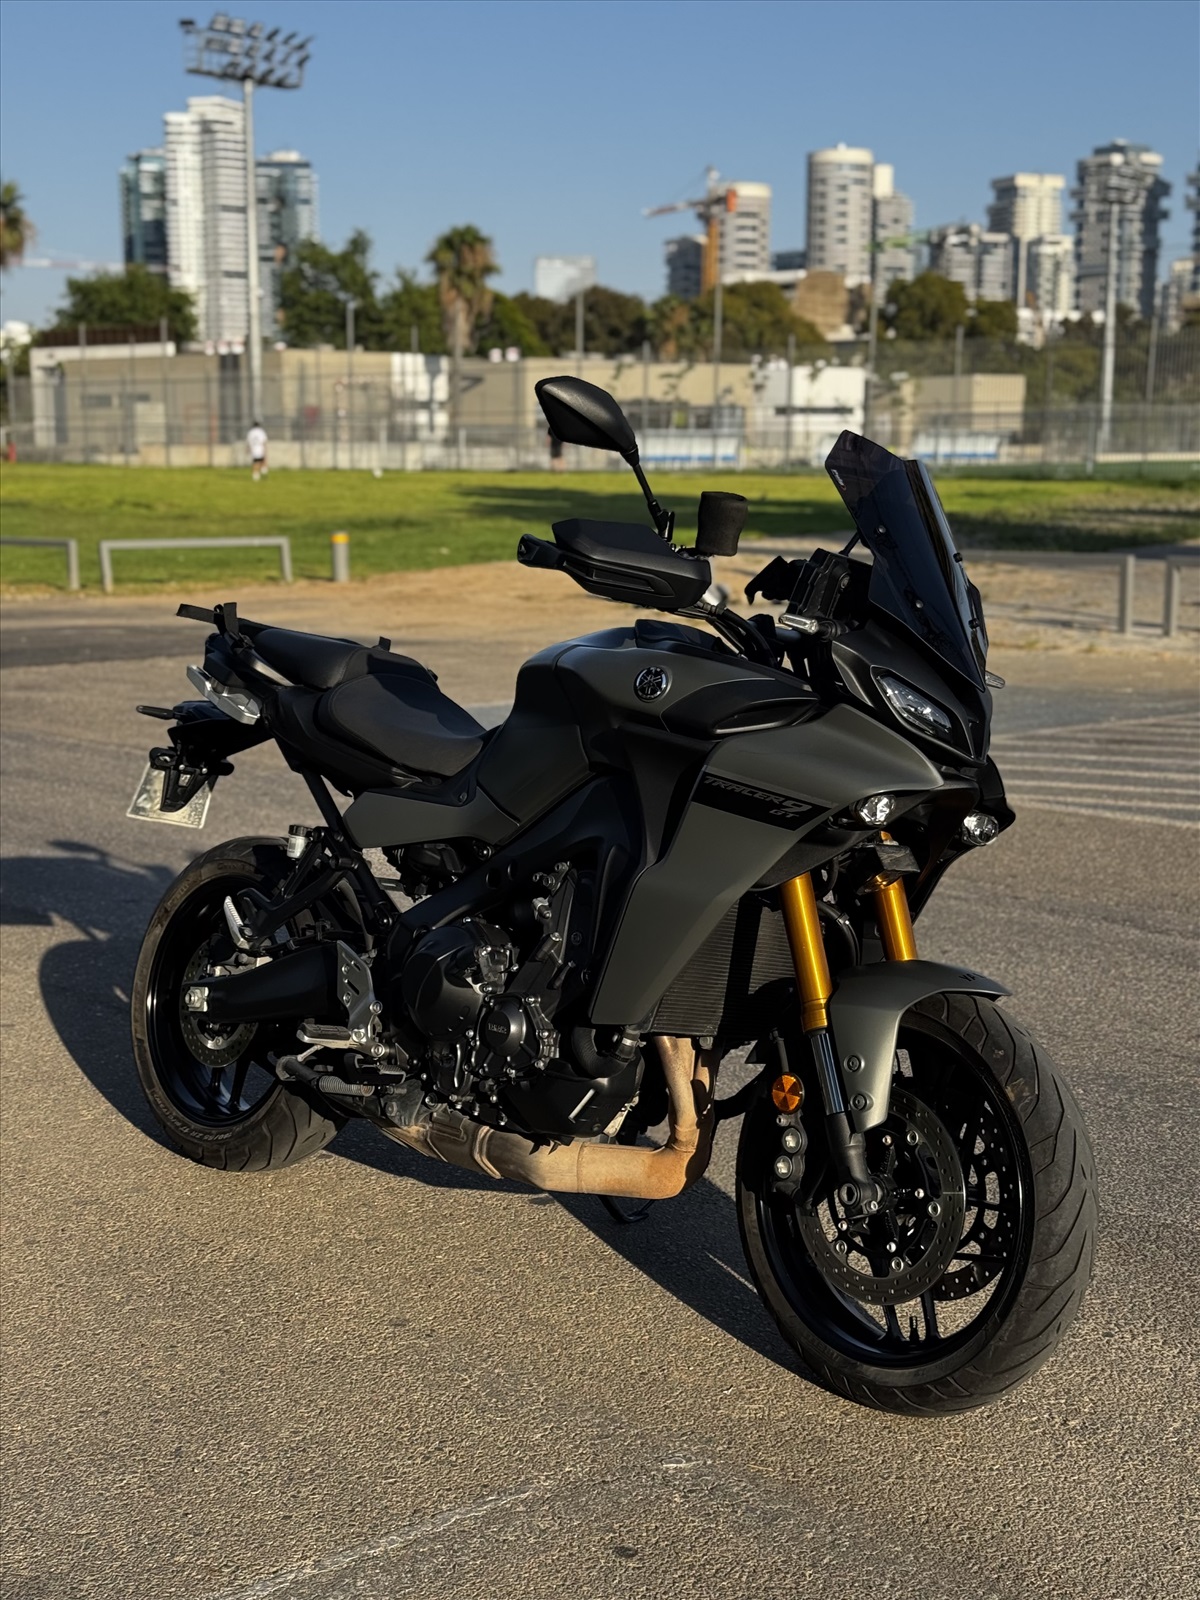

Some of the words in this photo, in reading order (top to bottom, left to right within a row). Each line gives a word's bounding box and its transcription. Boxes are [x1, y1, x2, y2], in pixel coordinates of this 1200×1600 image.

[703, 775, 785, 805] TRACER
[782, 800, 813, 812] 9
[768, 808, 800, 819] GT
